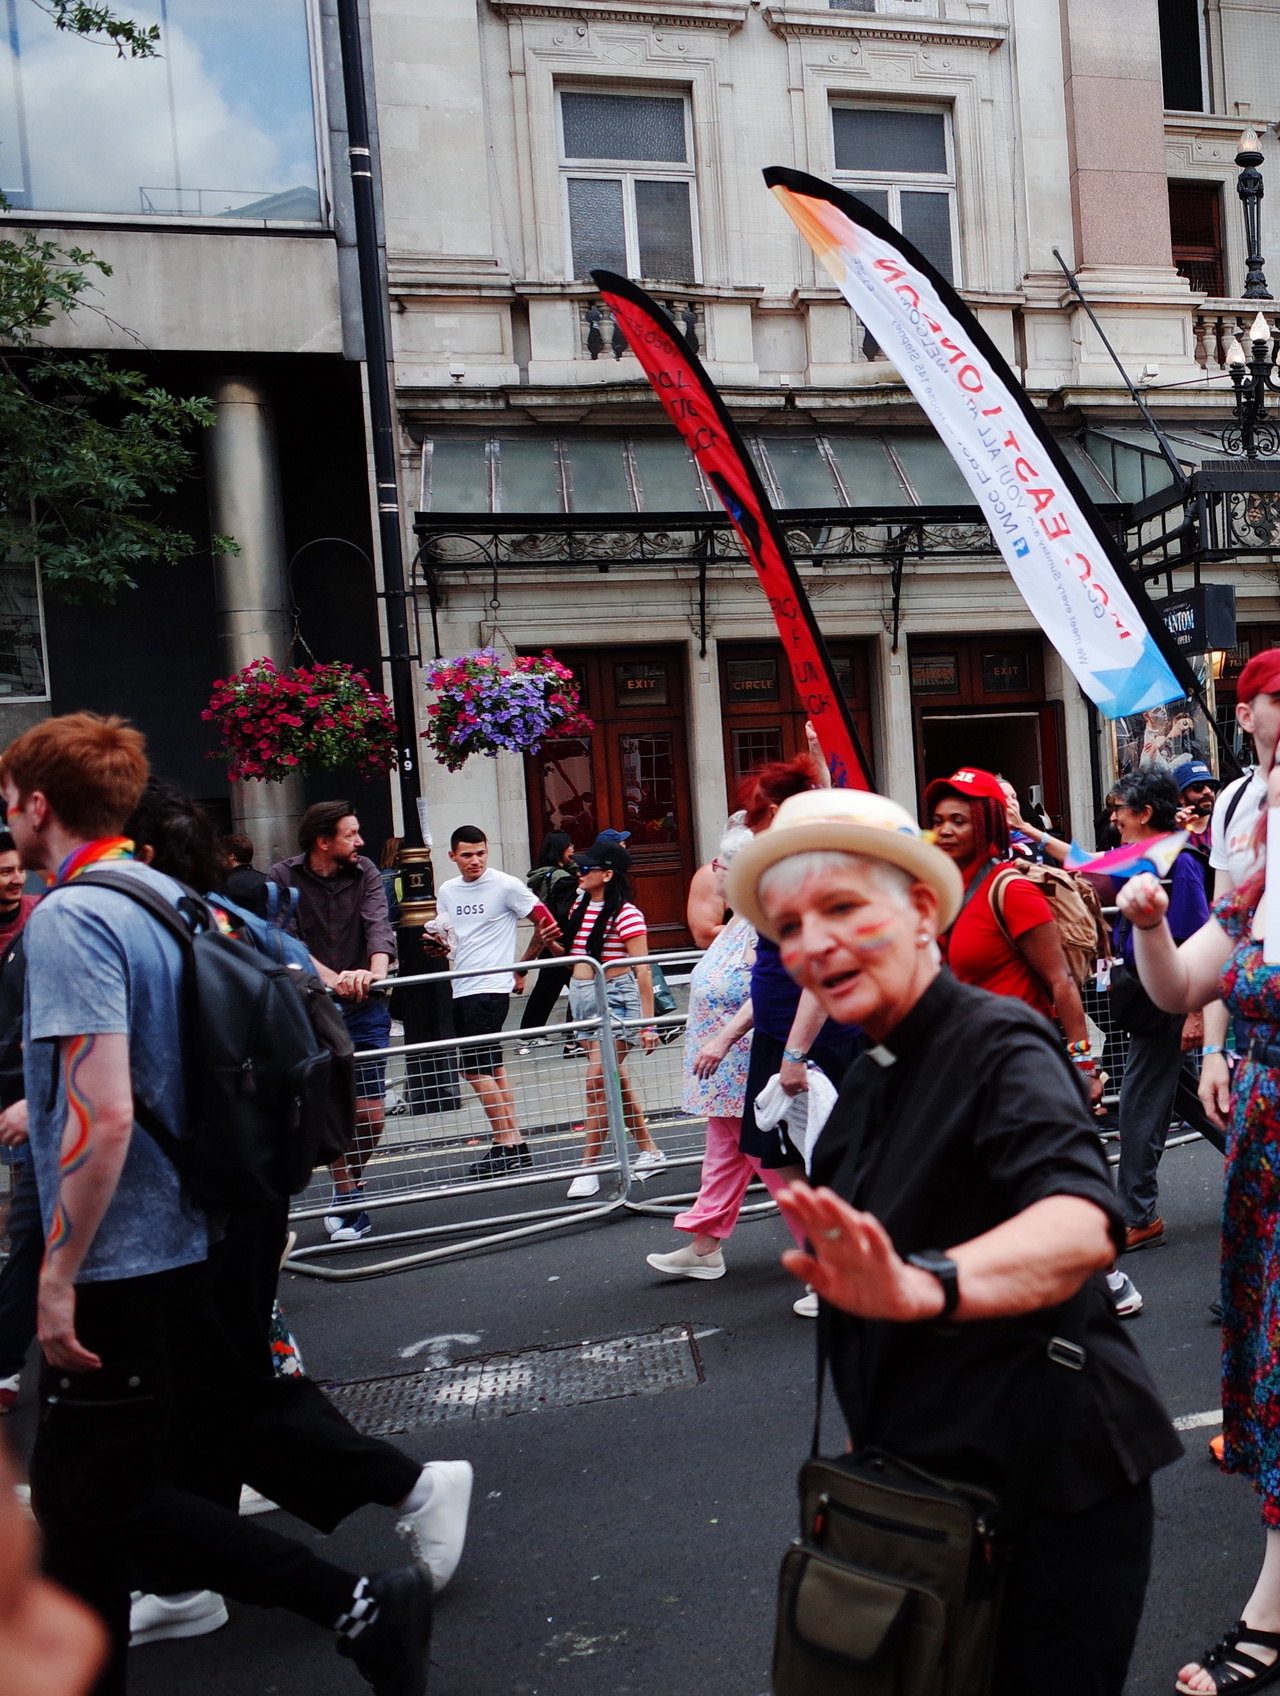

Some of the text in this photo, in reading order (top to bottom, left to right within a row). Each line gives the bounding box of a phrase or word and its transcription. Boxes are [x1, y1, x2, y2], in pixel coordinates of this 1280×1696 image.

[994, 666, 1019, 676] EXIT
[627, 679, 656, 689] EXIT
[733, 680, 773, 690] CIRCLE
[456, 904, 485, 915] BOSS
